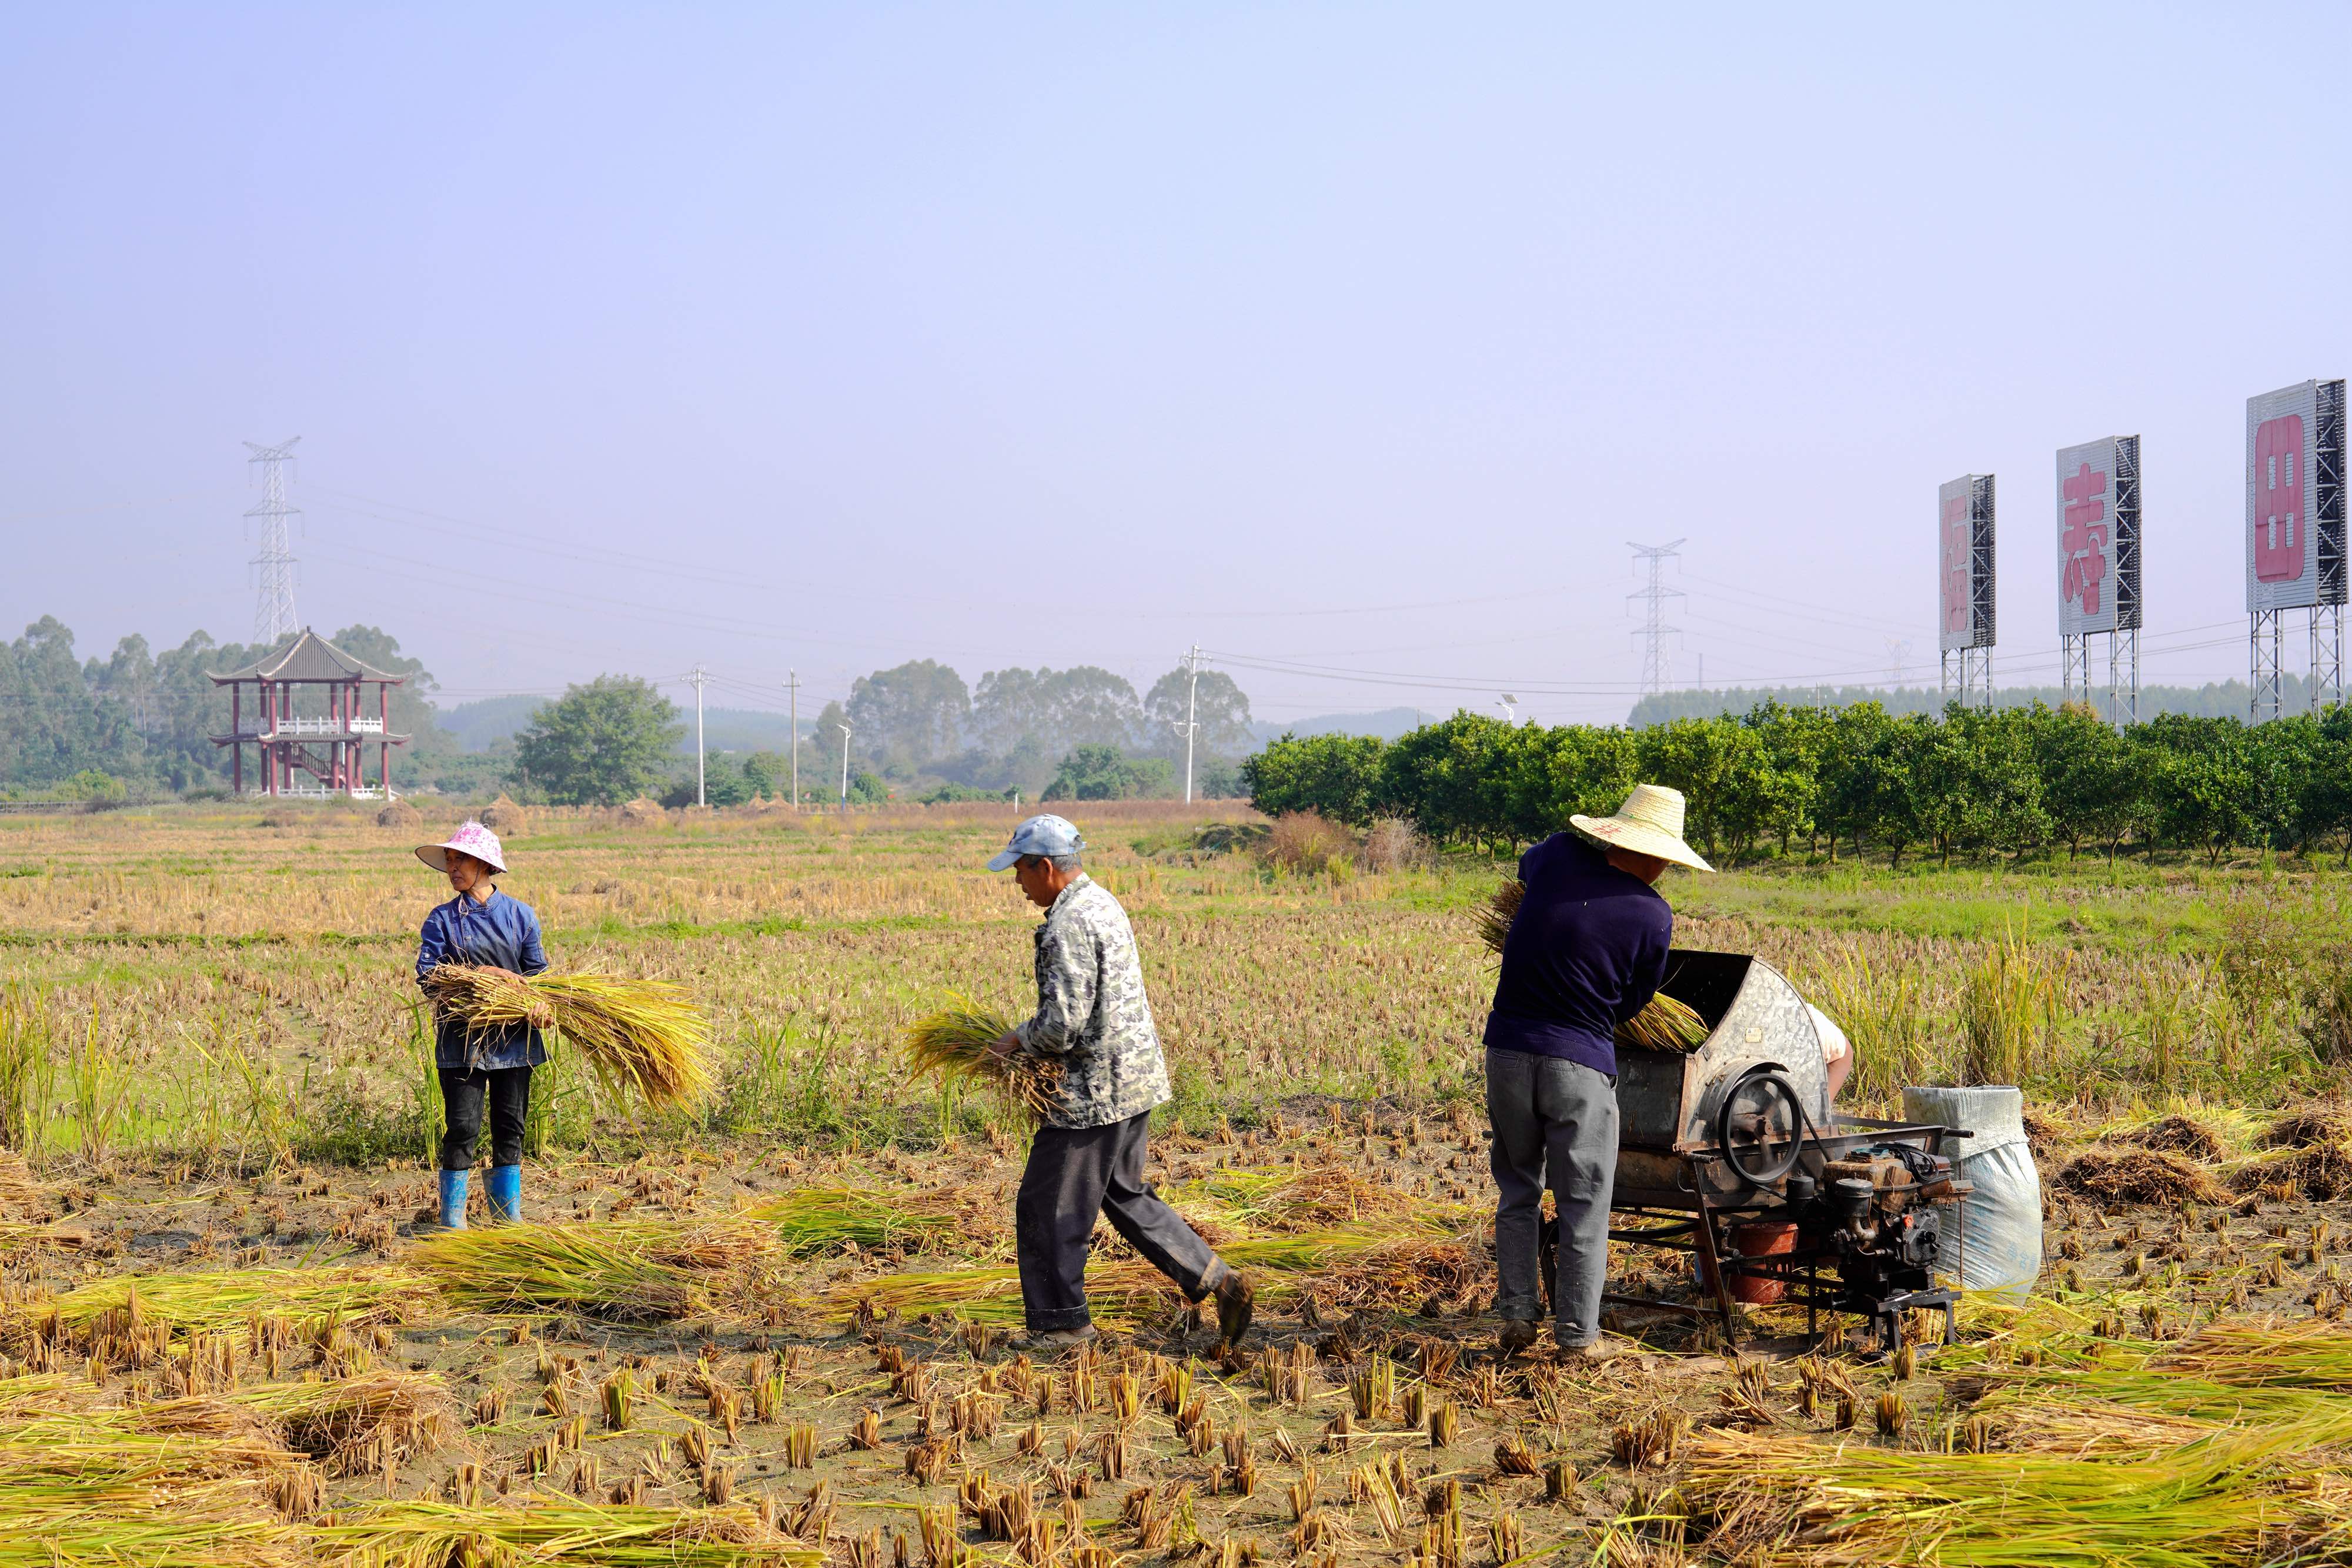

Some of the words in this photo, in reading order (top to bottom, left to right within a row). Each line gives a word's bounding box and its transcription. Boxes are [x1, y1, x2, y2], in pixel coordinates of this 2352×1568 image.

[1942, 495, 1967, 634] 福
[2063, 462, 2107, 615] 寿
[2255, 414, 2304, 583] 田
